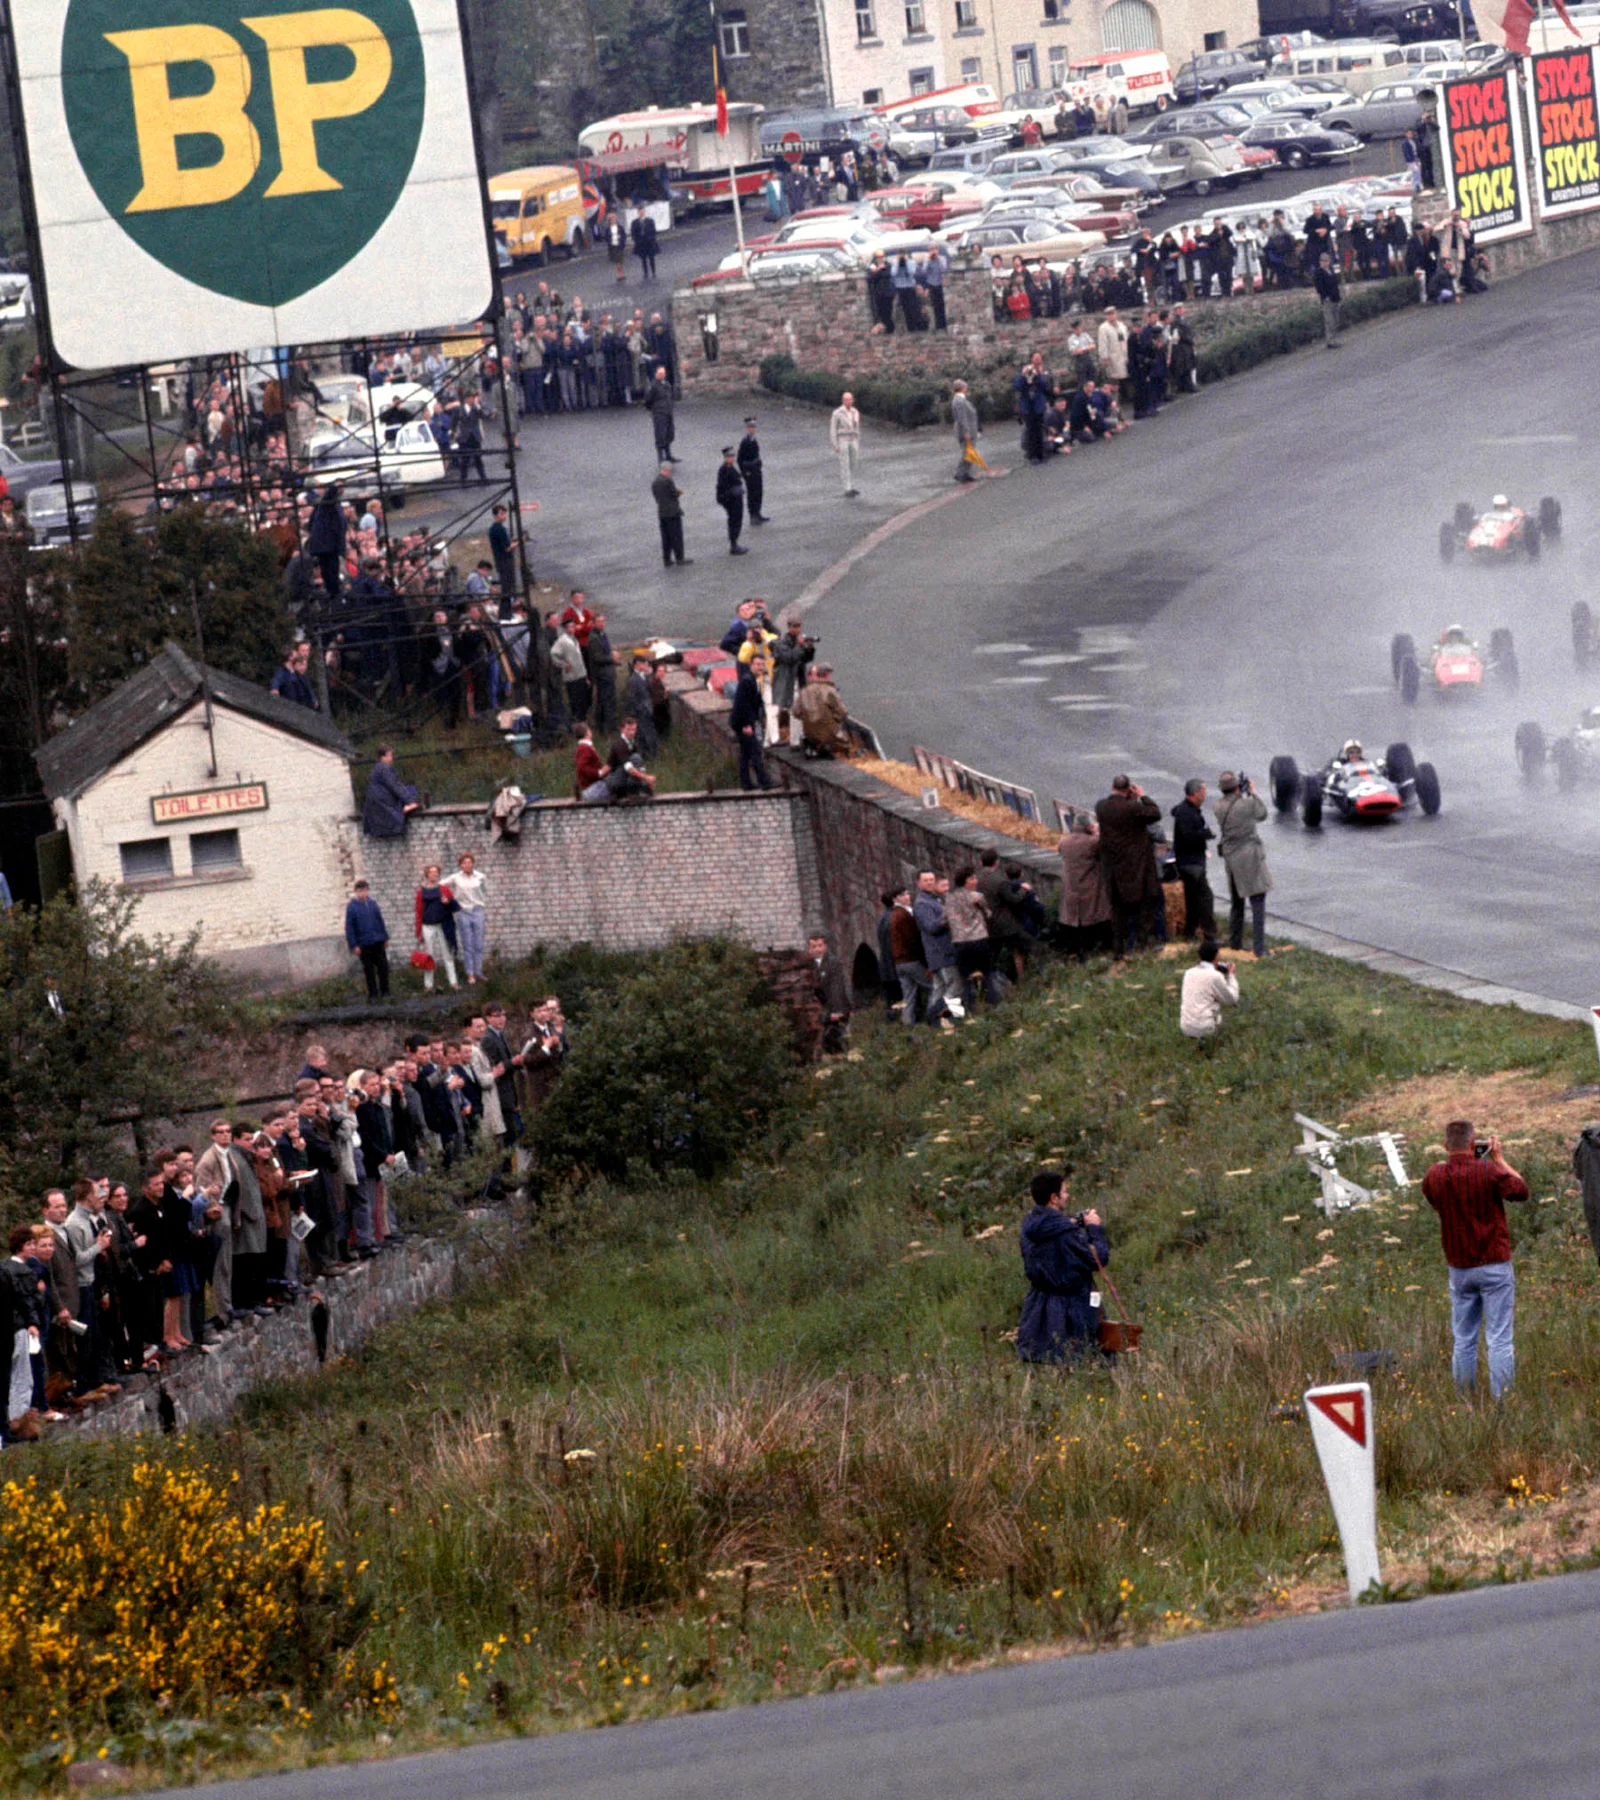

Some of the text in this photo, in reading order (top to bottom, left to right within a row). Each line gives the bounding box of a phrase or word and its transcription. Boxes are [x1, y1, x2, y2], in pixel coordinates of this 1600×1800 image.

[1536, 54, 1592, 101] STOCK
[103, 8, 393, 213] BP
[1448, 78, 1506, 129] STOCK
[1541, 98, 1596, 145] STOCK
[764, 141, 820, 154] MARTINI
[1453, 123, 1511, 174] STOCK
[1545, 140, 1600, 189] STOCK
[1458, 166, 1515, 219] STOCK
[156, 787, 261, 817] TOILETTES
